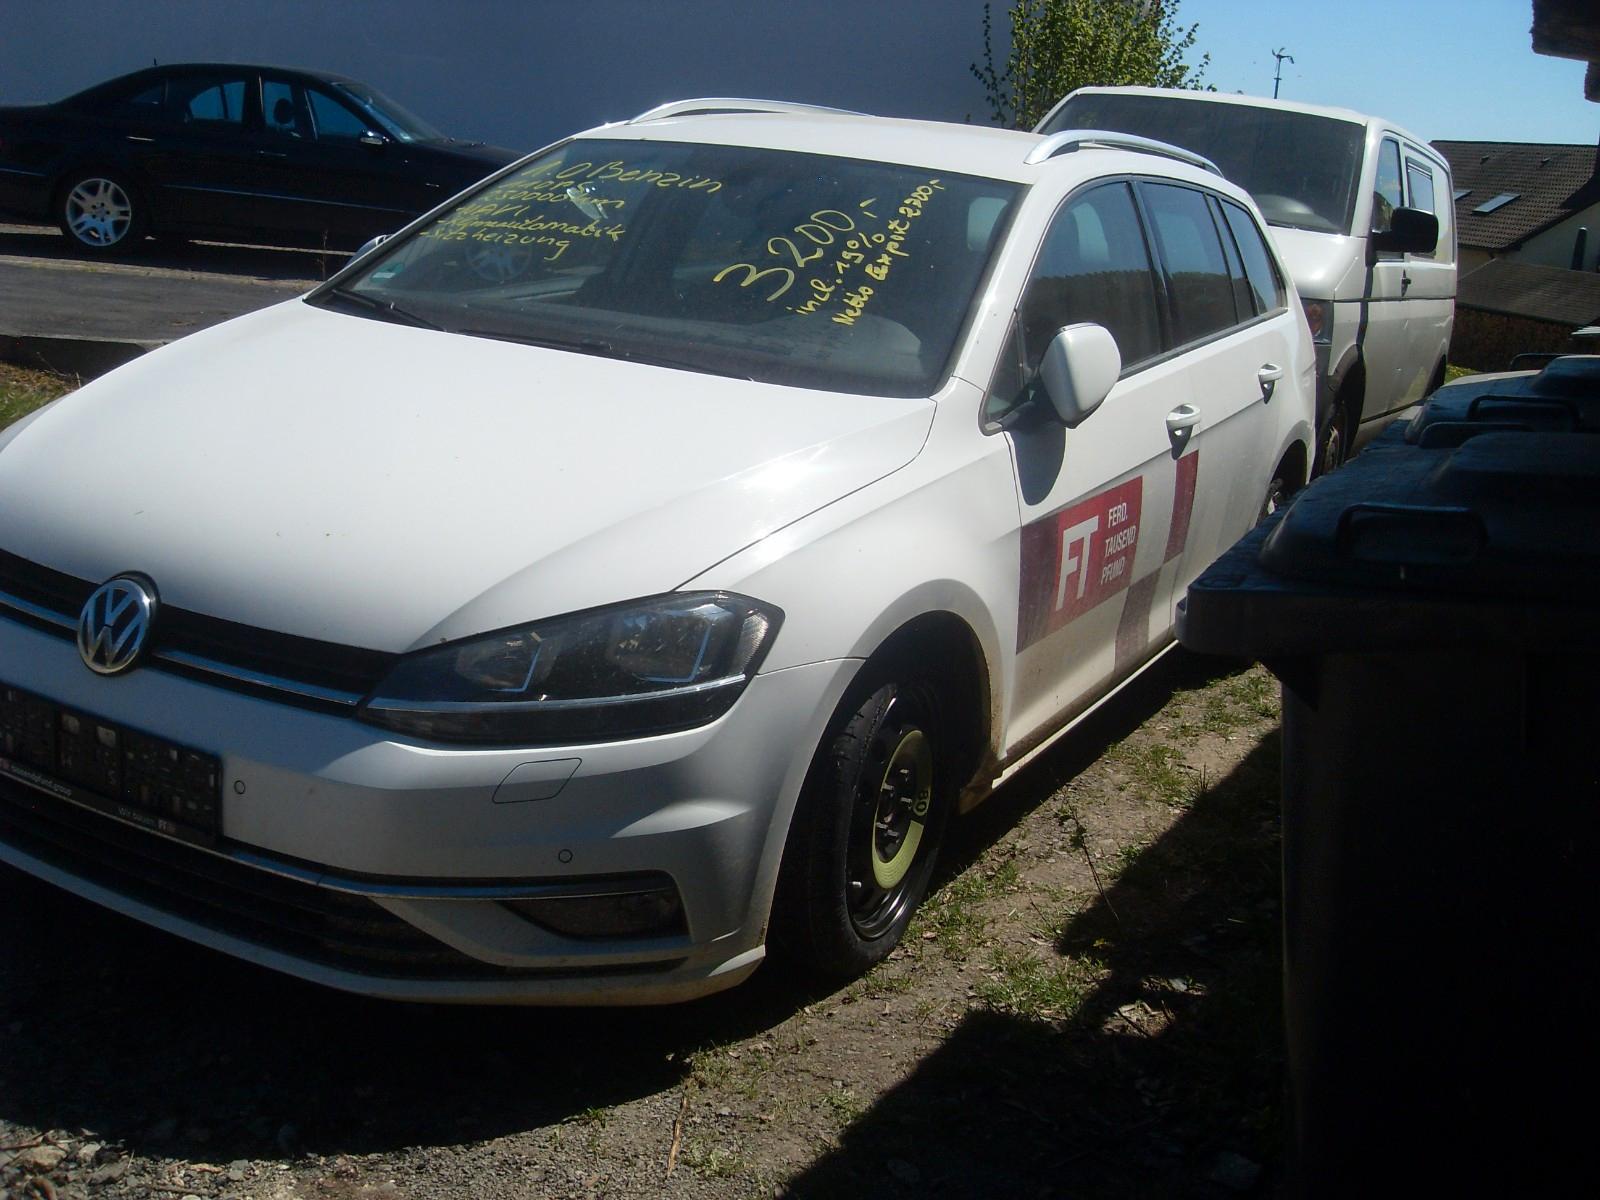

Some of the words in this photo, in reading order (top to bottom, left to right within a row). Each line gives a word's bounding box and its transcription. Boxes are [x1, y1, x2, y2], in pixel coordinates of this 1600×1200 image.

[592, 161, 722, 194] Benzin
[1107, 502, 1128, 529] FERD.
[1104, 525, 1137, 558] TAUSEND
[1056, 515, 1099, 611] FT
[1100, 556, 1126, 585] PFUND
